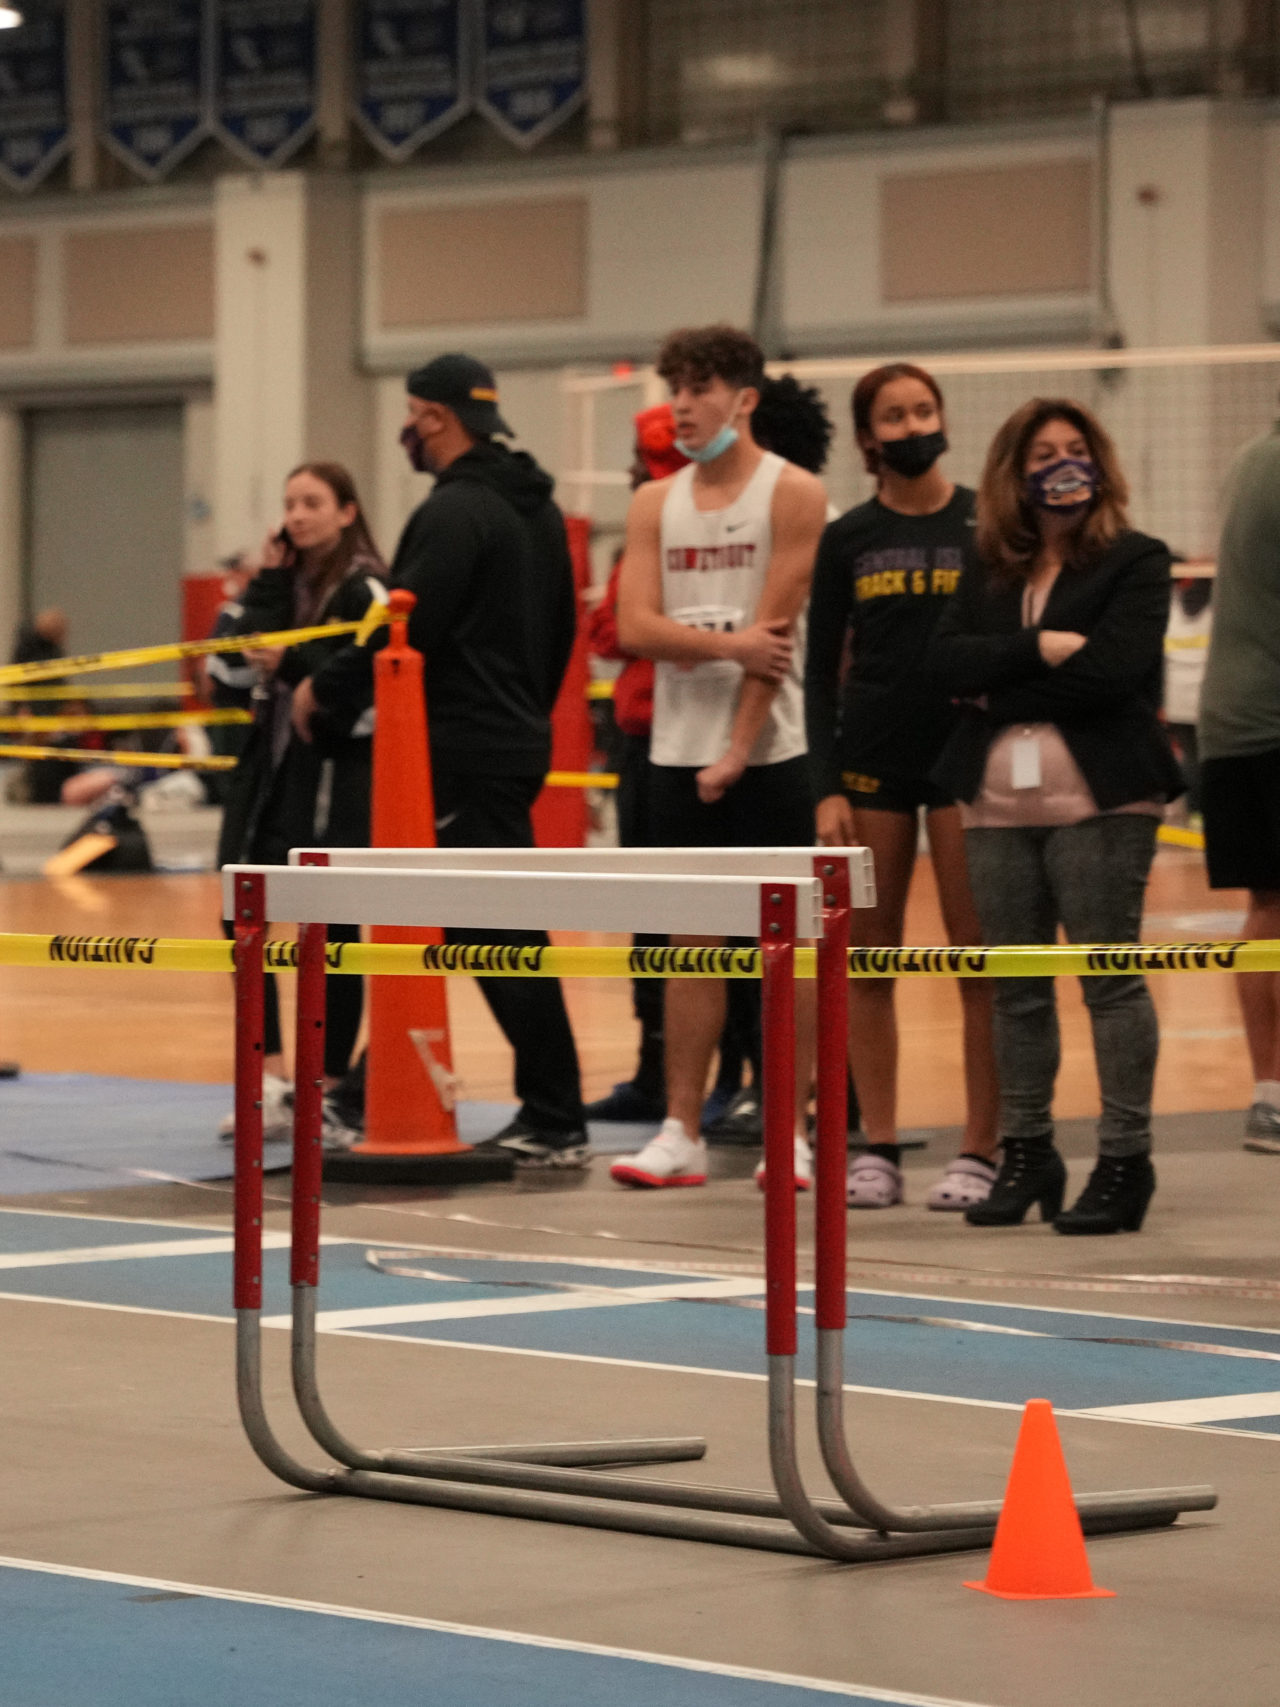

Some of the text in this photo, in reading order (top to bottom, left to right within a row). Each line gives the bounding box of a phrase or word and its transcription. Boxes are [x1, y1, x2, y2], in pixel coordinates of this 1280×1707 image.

[49, 935, 160, 964] CAUTION
[423, 944, 545, 971] CAUTION
[629, 947, 762, 973] CAUTION
[849, 947, 989, 972] CAUTION
[1087, 942, 1249, 970] CAUTION
